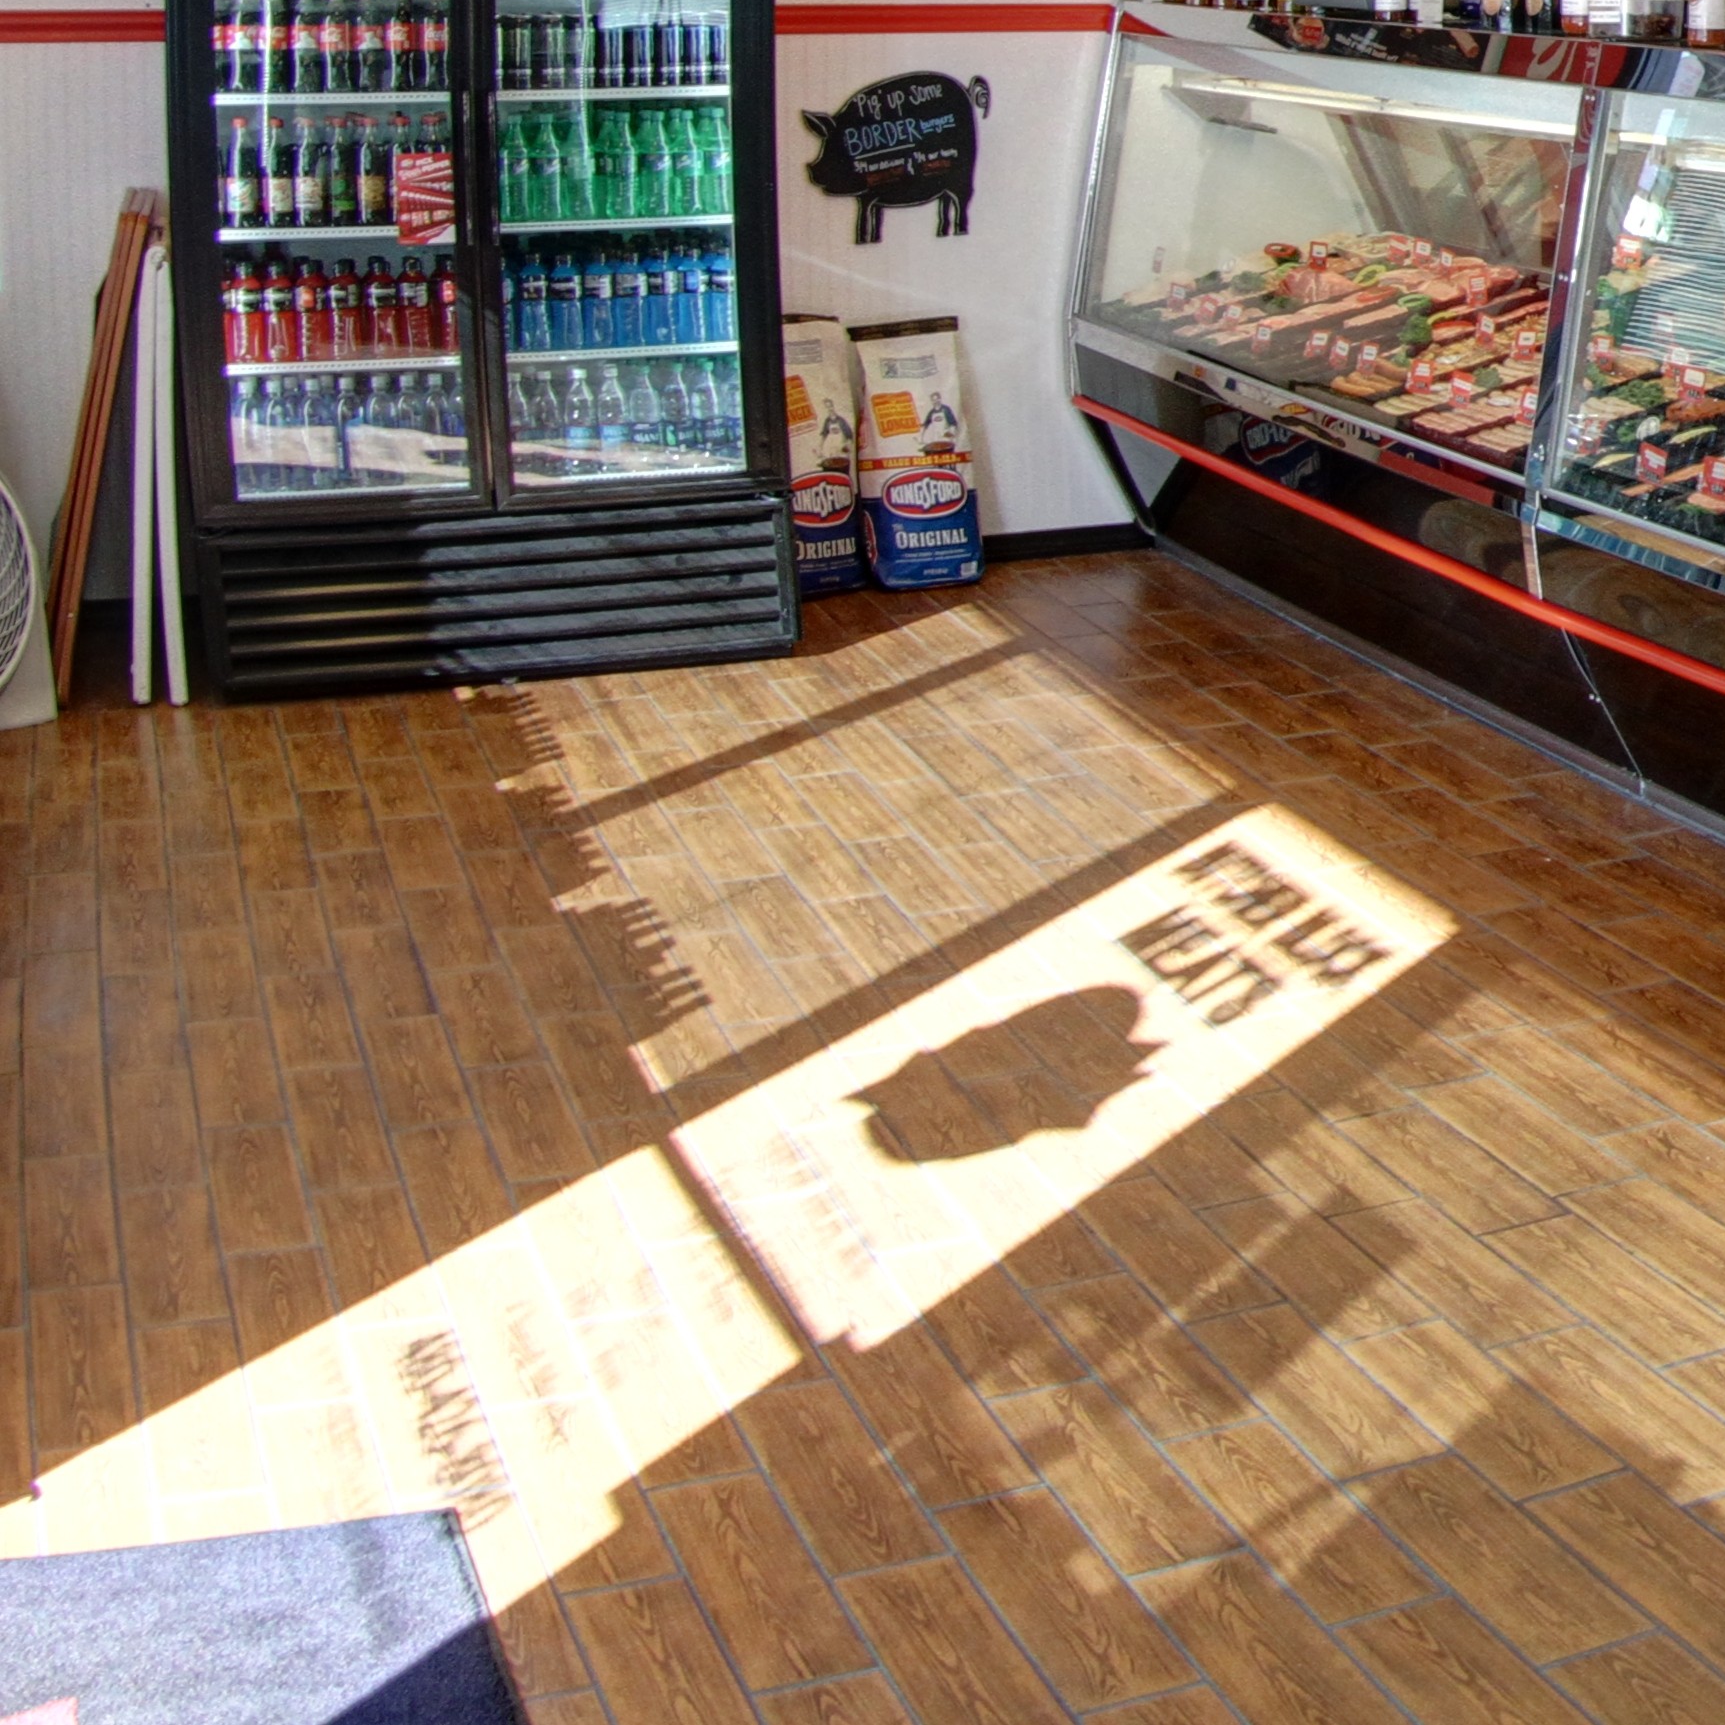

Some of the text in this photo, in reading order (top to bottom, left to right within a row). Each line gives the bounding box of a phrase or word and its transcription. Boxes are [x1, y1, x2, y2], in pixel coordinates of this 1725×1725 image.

[844, 118, 922, 156] BORDER
[890, 476, 963, 510] KINGSFORD
[896, 527, 968, 550] ORIGINAL
